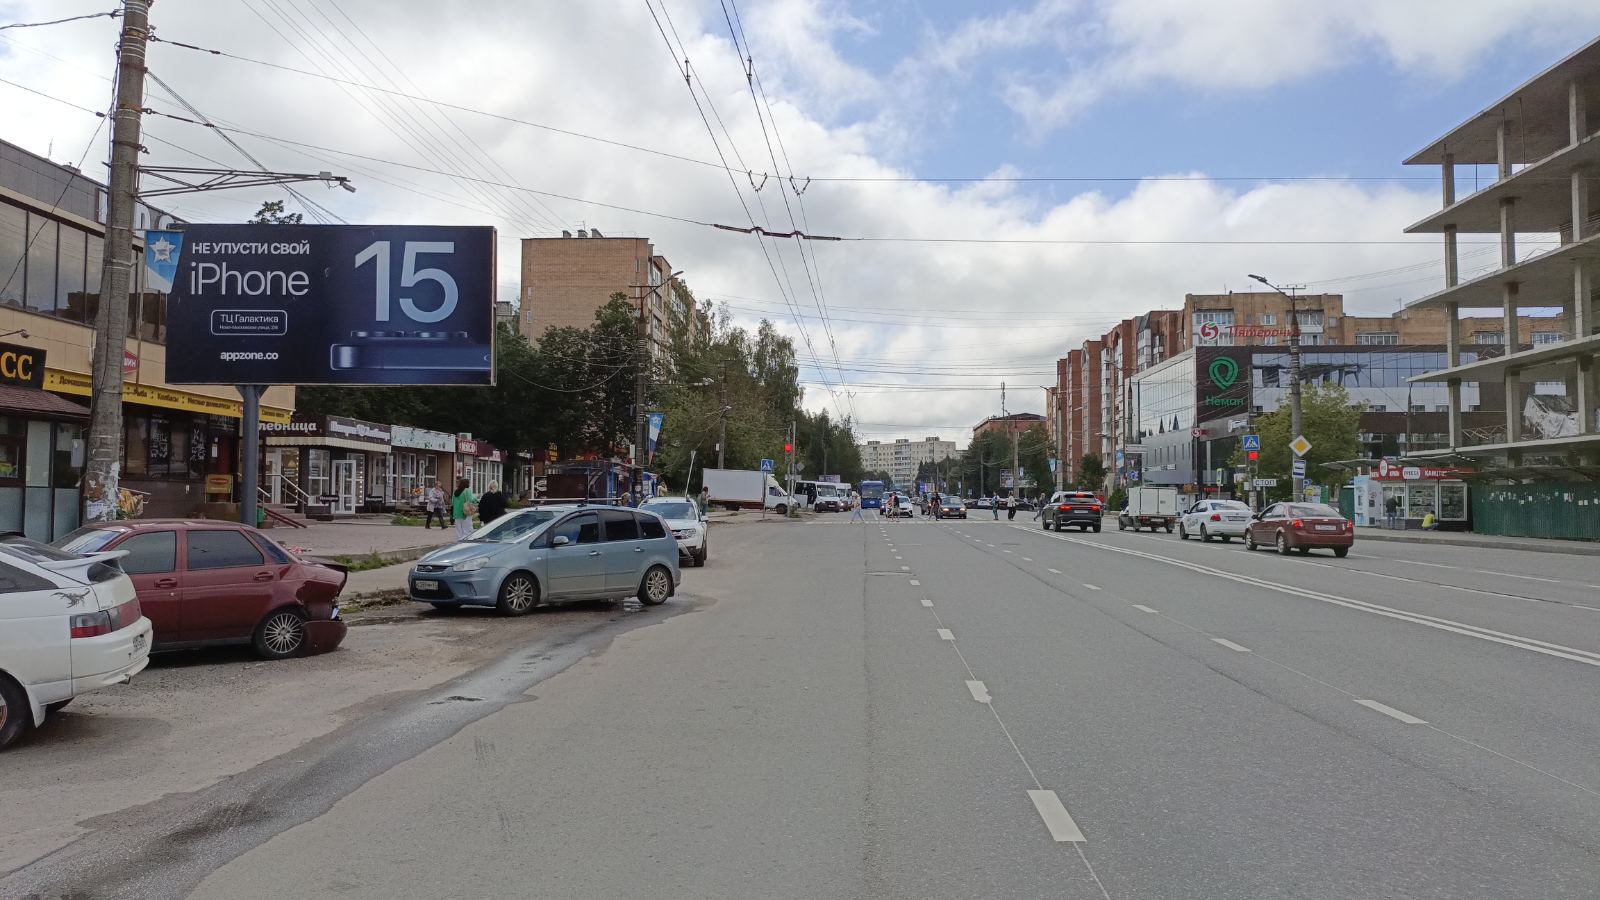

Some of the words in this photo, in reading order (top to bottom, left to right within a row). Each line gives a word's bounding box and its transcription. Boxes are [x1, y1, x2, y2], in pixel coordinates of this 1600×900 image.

[192, 242, 211, 254] НЕ
[212, 242, 268, 255] УПУСТИ
[270, 240, 310, 255] СВОЙ
[191, 261, 310, 296] iPhone
[354, 240, 459, 323] 15
[220, 314, 234, 323] ТЦ
[235, 314, 279, 323] Галактика
[1225, 325, 1302, 340] Пятероча
[220, 351, 279, 361] appzone.co
[1205, 395, 1244, 406] Неман
